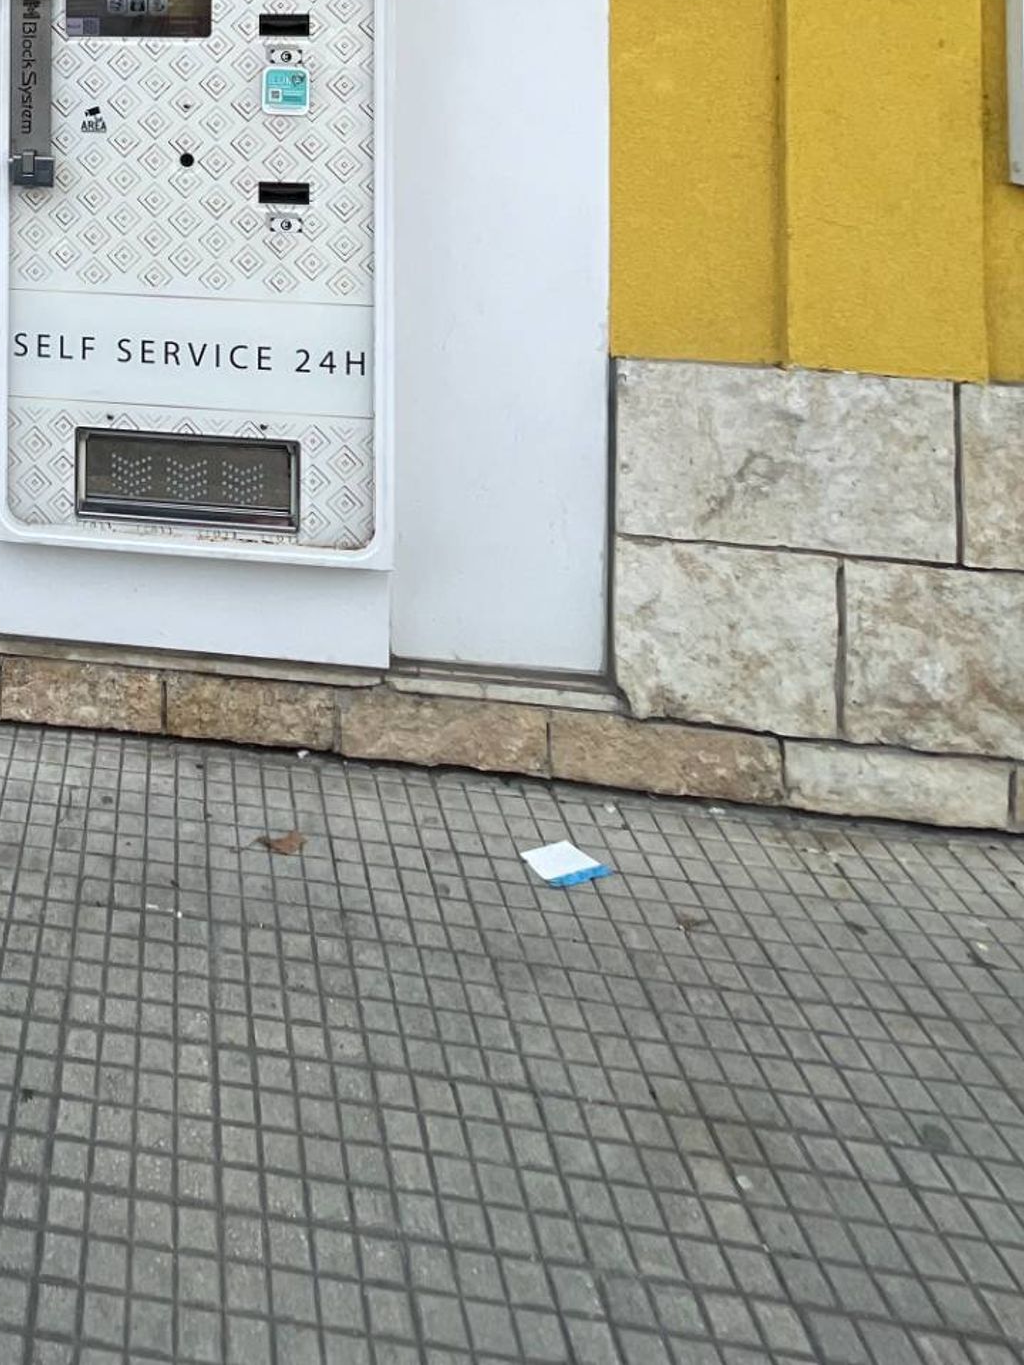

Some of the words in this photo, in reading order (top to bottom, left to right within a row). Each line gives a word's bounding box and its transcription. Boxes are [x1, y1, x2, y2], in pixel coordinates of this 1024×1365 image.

[21, 22, 37, 69] Block
[18, 71, 37, 135] System
[81, 120, 106, 131] AREA
[15, 333, 96, 360] SELF
[117, 339, 273, 371] SERVICE
[295, 349, 367, 376] 24H
